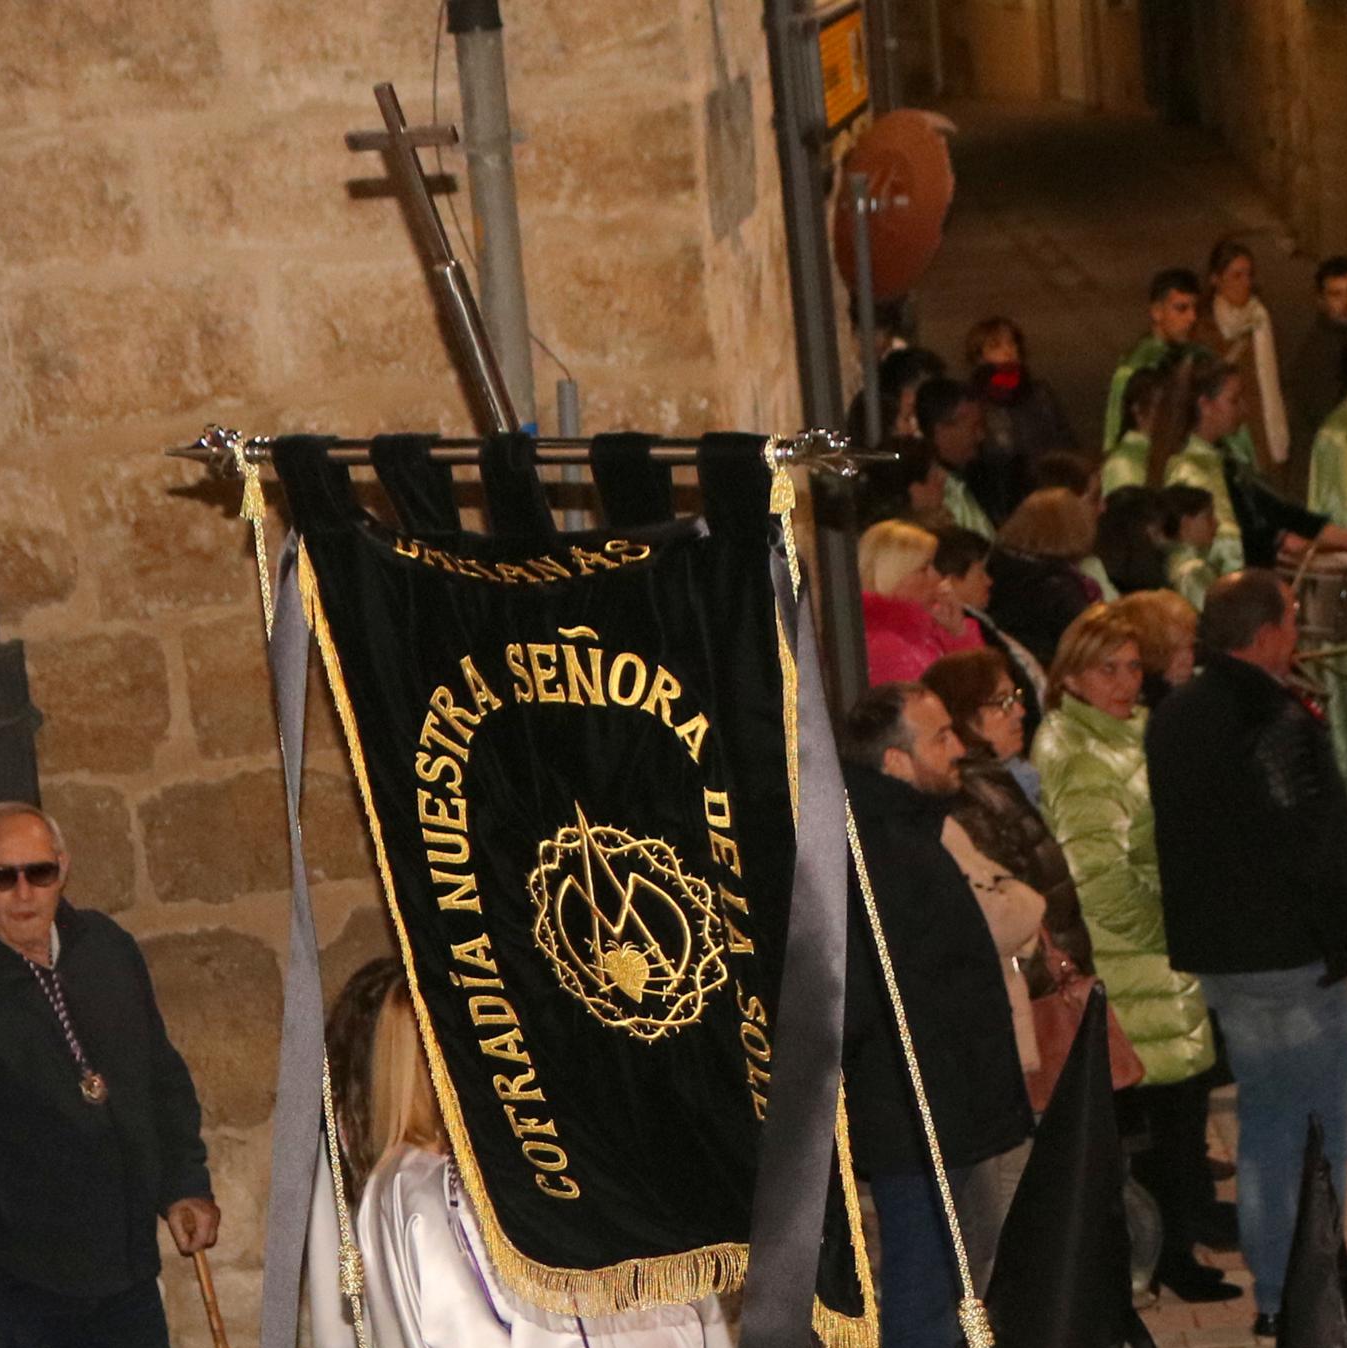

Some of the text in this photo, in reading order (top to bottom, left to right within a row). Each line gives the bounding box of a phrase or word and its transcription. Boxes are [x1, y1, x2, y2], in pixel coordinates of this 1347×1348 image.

[506, 626, 710, 766] SEÑORA
[417, 655, 502, 914] NUESTRA
[703, 786, 742, 878] DE
[718, 882, 754, 955] LA
[452, 932, 580, 1200] COFRADÍA
